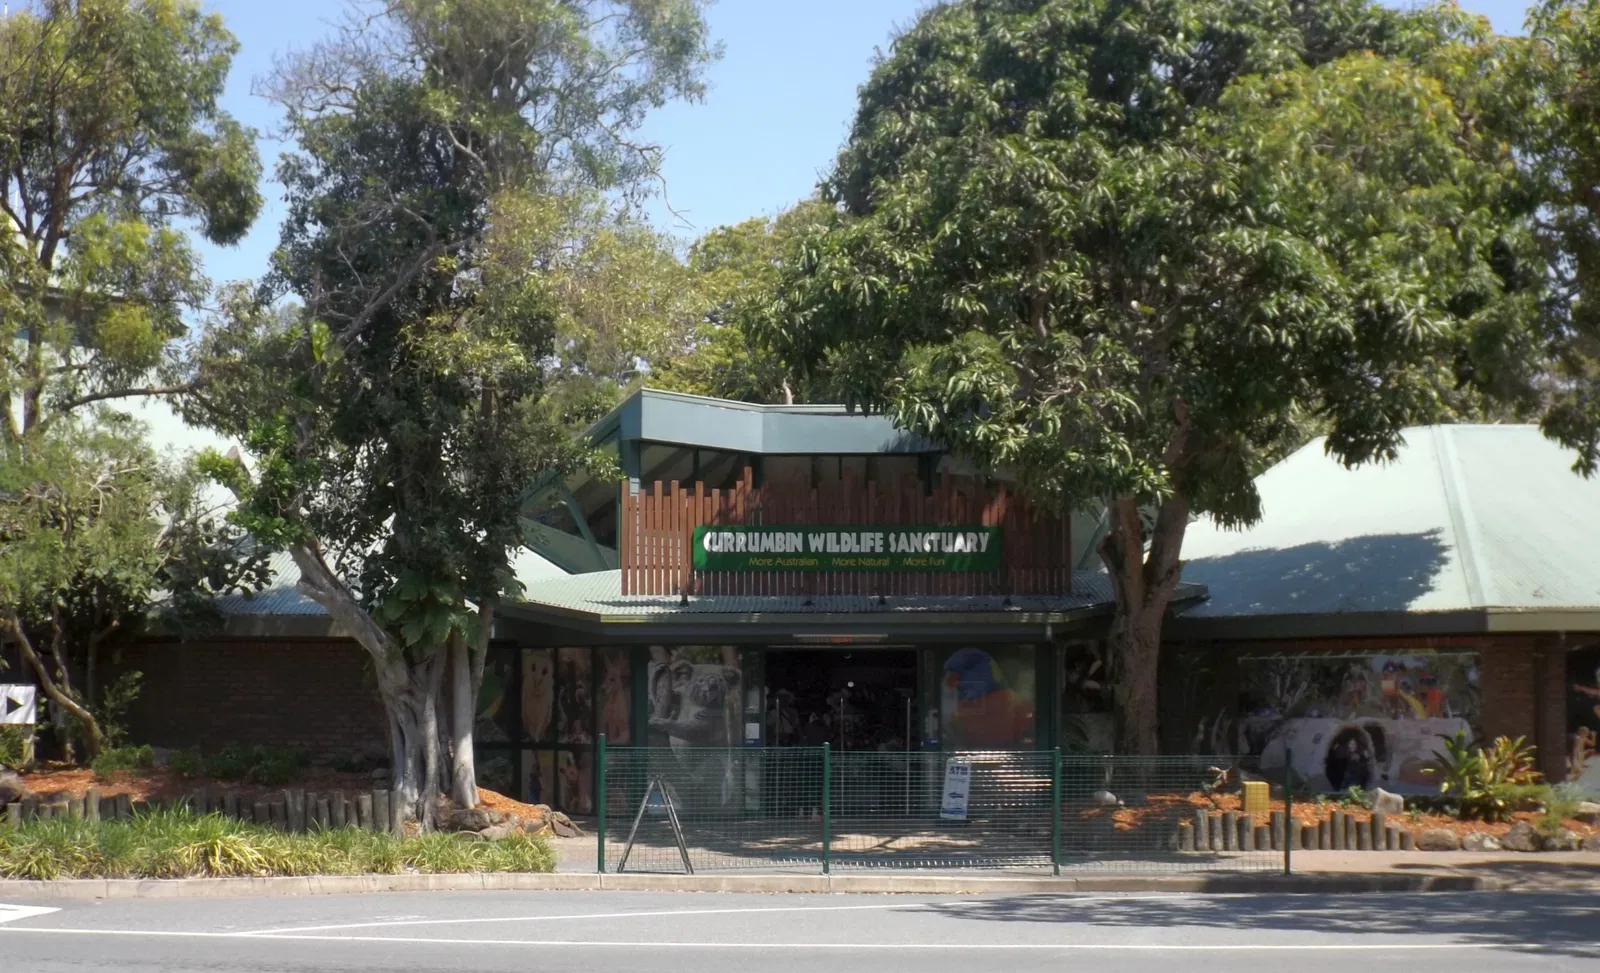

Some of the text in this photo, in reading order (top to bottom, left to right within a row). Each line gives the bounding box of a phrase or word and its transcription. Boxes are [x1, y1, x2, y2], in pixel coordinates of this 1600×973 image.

[703, 531, 990, 553] CURRUMBIN WILDLIFE SANCTUARY
[748, 557, 945, 566] More Australian More Natural More Fun
[949, 766, 968, 776] ATM
